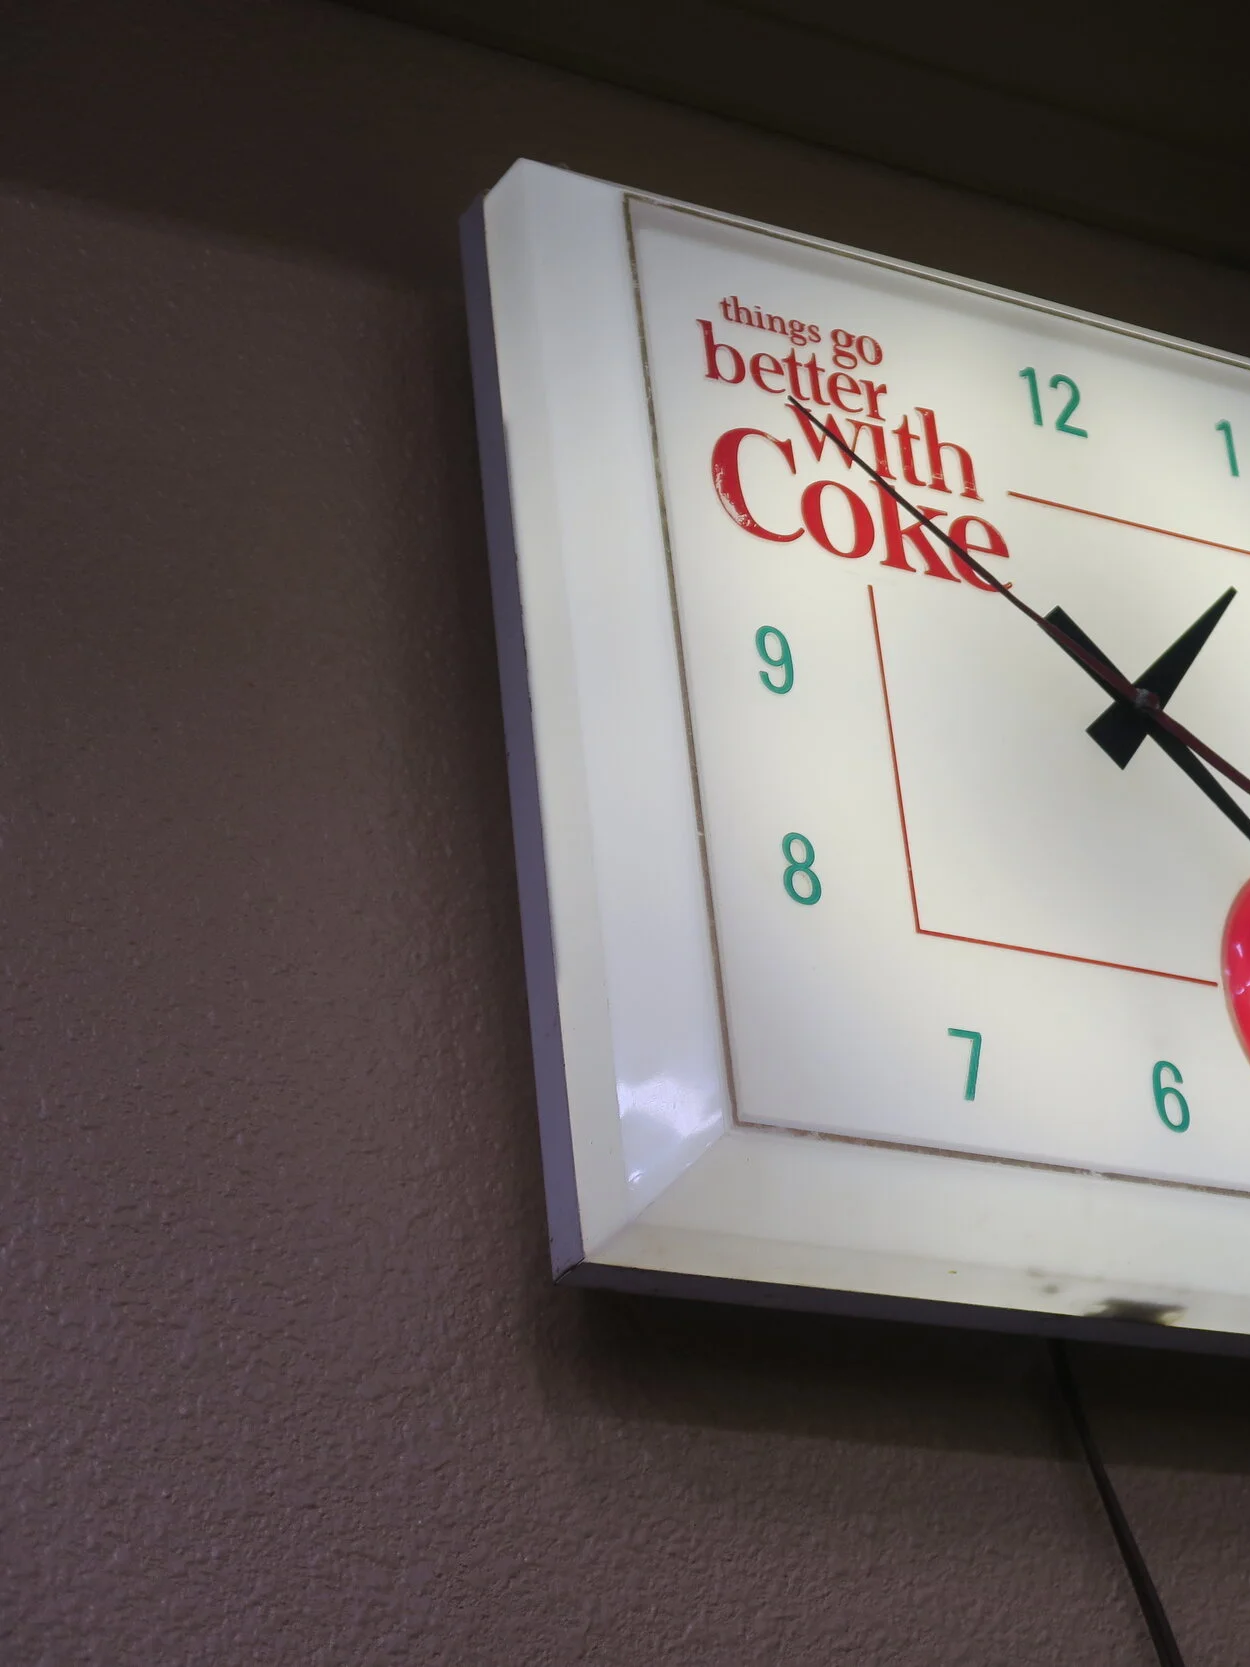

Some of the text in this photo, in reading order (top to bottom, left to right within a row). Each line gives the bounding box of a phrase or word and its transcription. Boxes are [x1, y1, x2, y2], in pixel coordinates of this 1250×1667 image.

[719, 296, 883, 369] things go
[697, 319, 888, 421] better
[1019, 366, 1089, 439] 12
[785, 404, 984, 501] with
[1215, 420, 1240, 478] 1
[711, 427, 1012, 592] Coke
[754, 624, 795, 695] 9
[781, 831, 822, 906] 8
[947, 1027, 982, 1102] 7
[1151, 1059, 1191, 1133] 6
